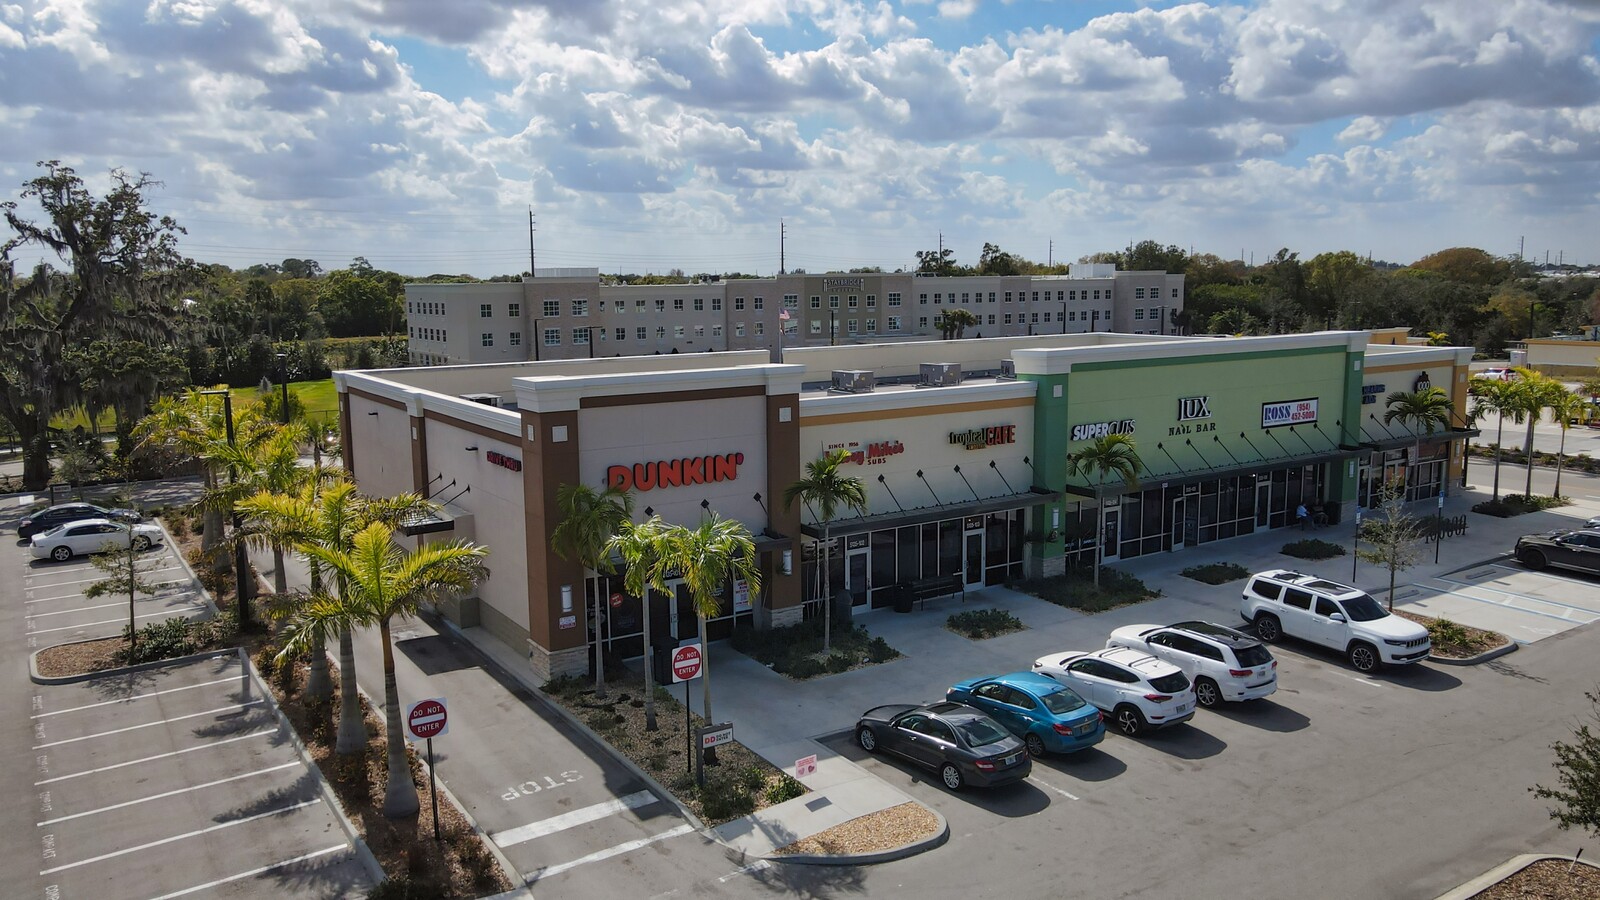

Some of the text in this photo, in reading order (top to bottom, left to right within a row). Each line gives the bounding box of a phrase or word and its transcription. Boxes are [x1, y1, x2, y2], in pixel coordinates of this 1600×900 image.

[1178, 396, 1212, 421] LUX
[1264, 405, 1291, 421] ROSS
[1071, 418, 1136, 441] SUPERCUTS
[1196, 422, 1216, 432] BAR
[986, 424, 1016, 446] CAFE
[867, 457, 887, 466] SUBS
[606, 452, 744, 493] DUNKIN'
[687, 650, 698, 659] NOT
[679, 665, 697, 675] ENTER
[413, 705, 441, 718] DO NOT
[417, 722, 441, 733] ENTER
[704, 736, 716, 744] DD
[501, 770, 584, 801] STOP
